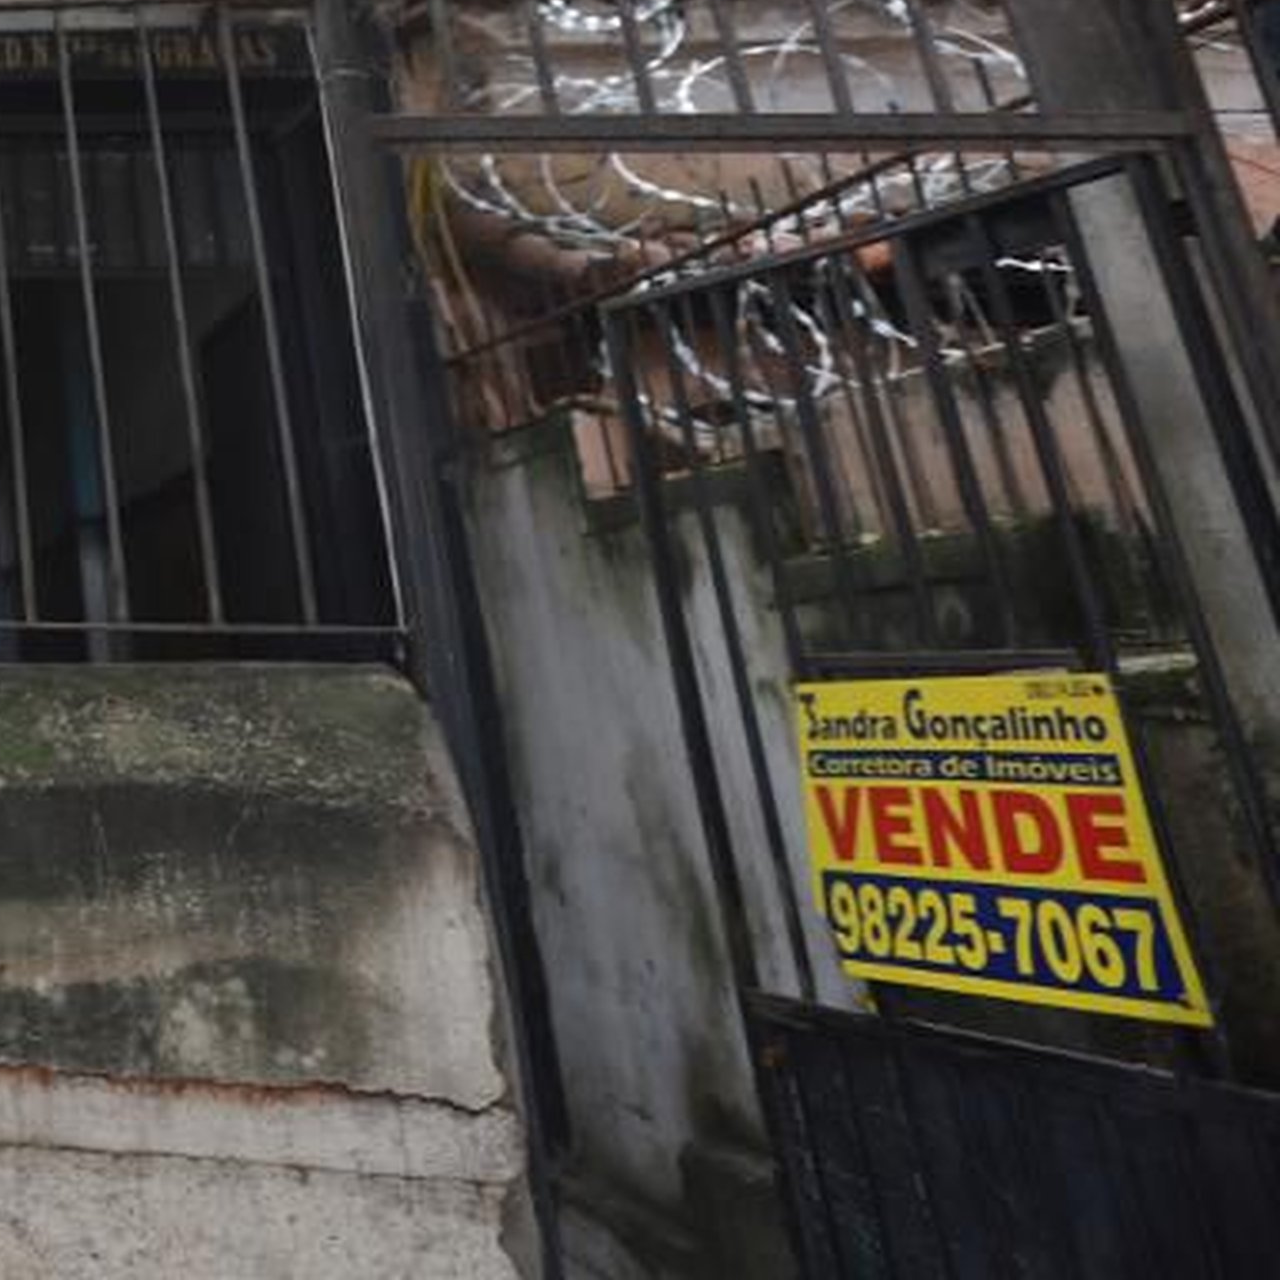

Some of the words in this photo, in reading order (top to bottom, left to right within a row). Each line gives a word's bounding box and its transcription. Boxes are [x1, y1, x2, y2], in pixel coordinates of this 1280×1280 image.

[152, 34, 276, 69] GRAAS
[800, 693, 897, 741] Sandra
[903, 689, 1108, 747] Gonçalinho
[809, 752, 933, 778] Corretora
[940, 756, 978, 778] de
[987, 753, 1117, 783] Imóveis
[813, 785, 1147, 884] VENDE
[829, 881, 1160, 991] 98225-7067
